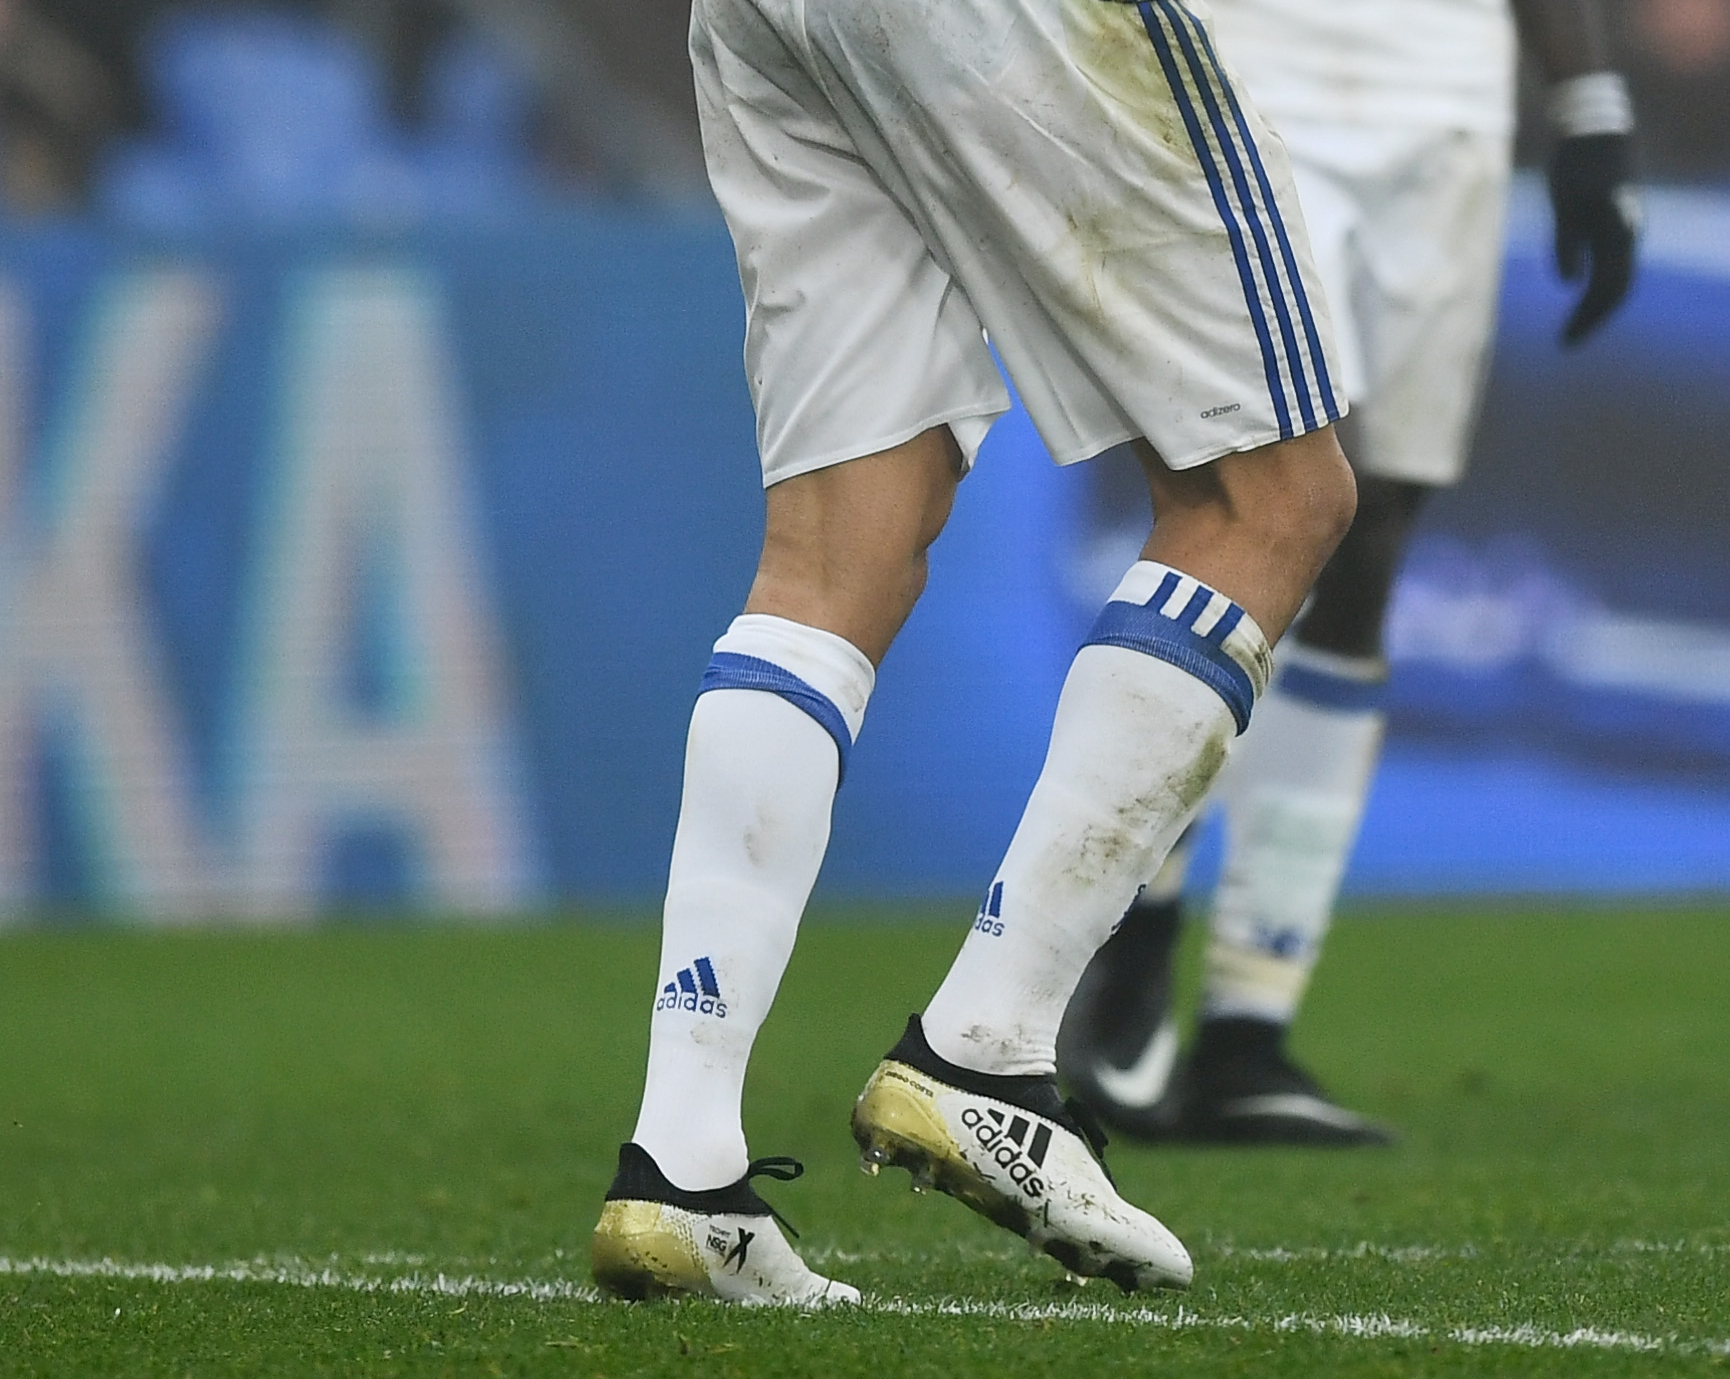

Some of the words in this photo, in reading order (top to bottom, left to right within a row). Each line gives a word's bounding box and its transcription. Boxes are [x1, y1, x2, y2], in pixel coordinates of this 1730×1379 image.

[1200, 403, 1241, 419] adizero
[656, 990, 728, 1019] adidas
[961, 1108, 1044, 1197] adidas
